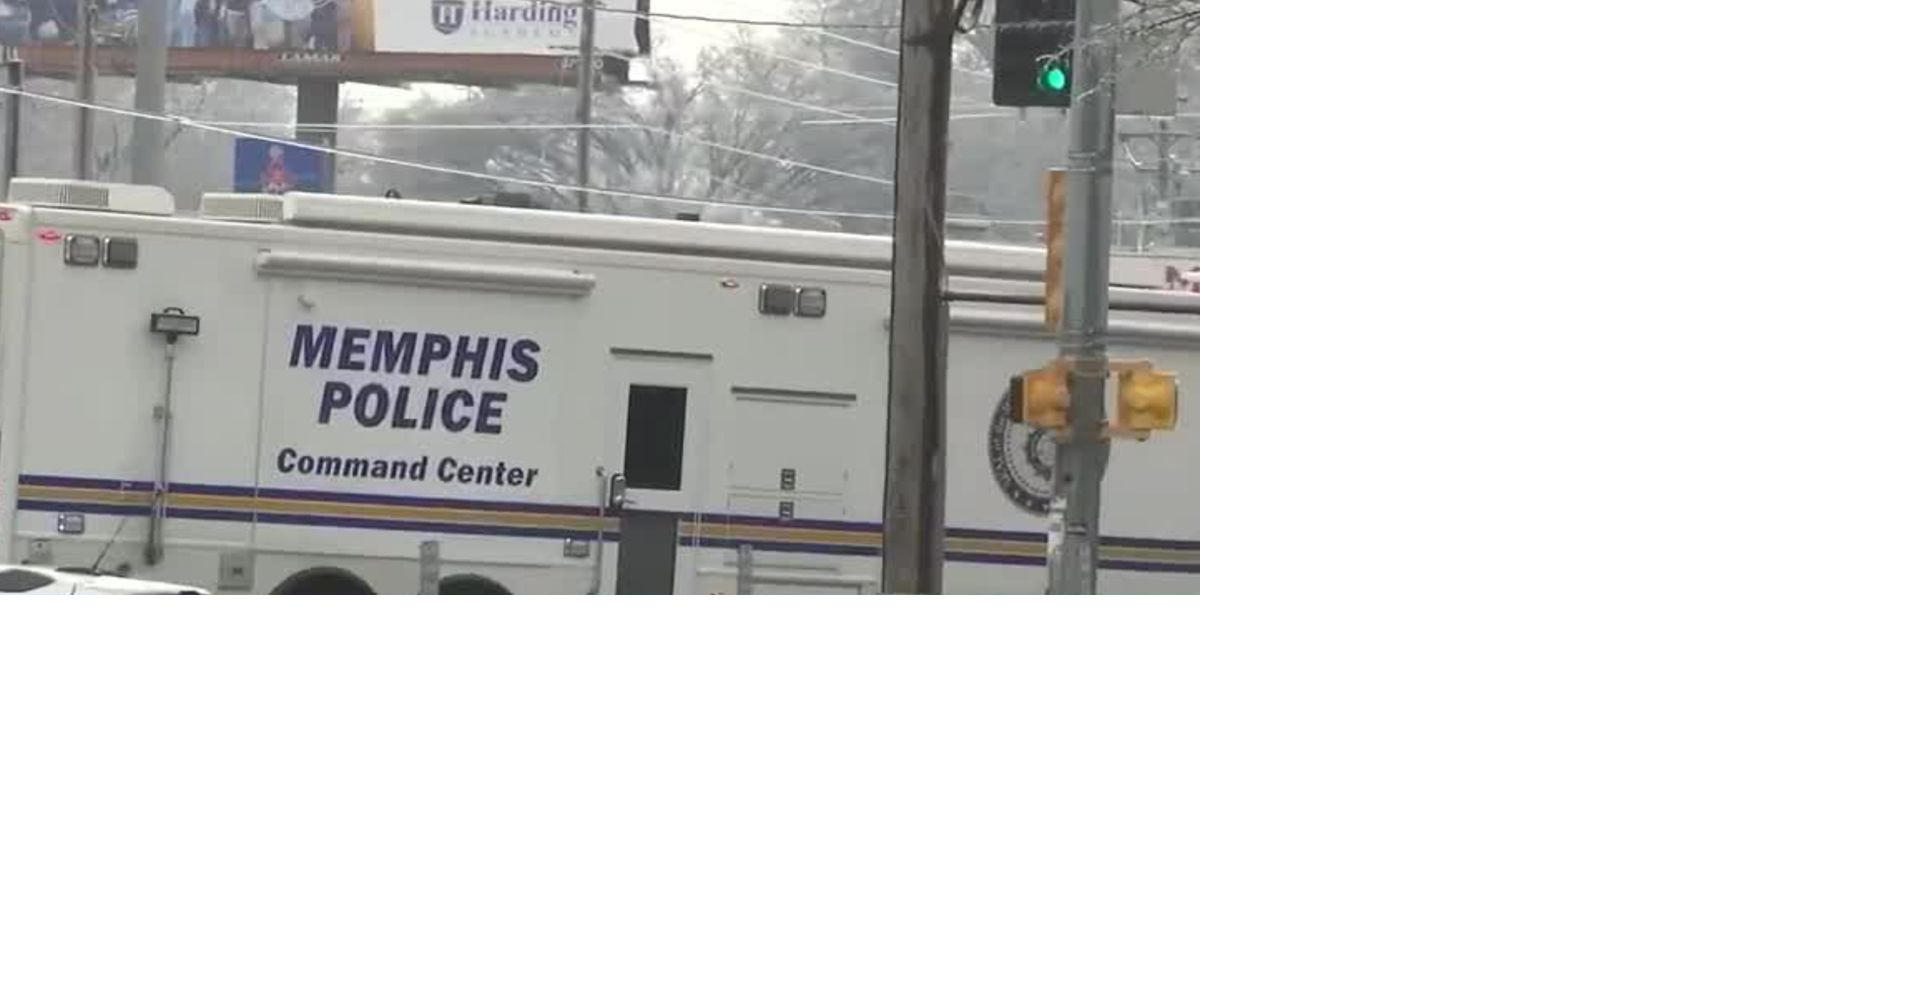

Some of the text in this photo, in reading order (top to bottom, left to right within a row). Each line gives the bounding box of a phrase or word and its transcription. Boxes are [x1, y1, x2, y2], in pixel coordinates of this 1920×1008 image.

[471, 0, 577, 33] Harding
[289, 324, 541, 382] MEMPHIS
[318, 381, 508, 434] POLICE
[277, 448, 539, 487] Command Center
